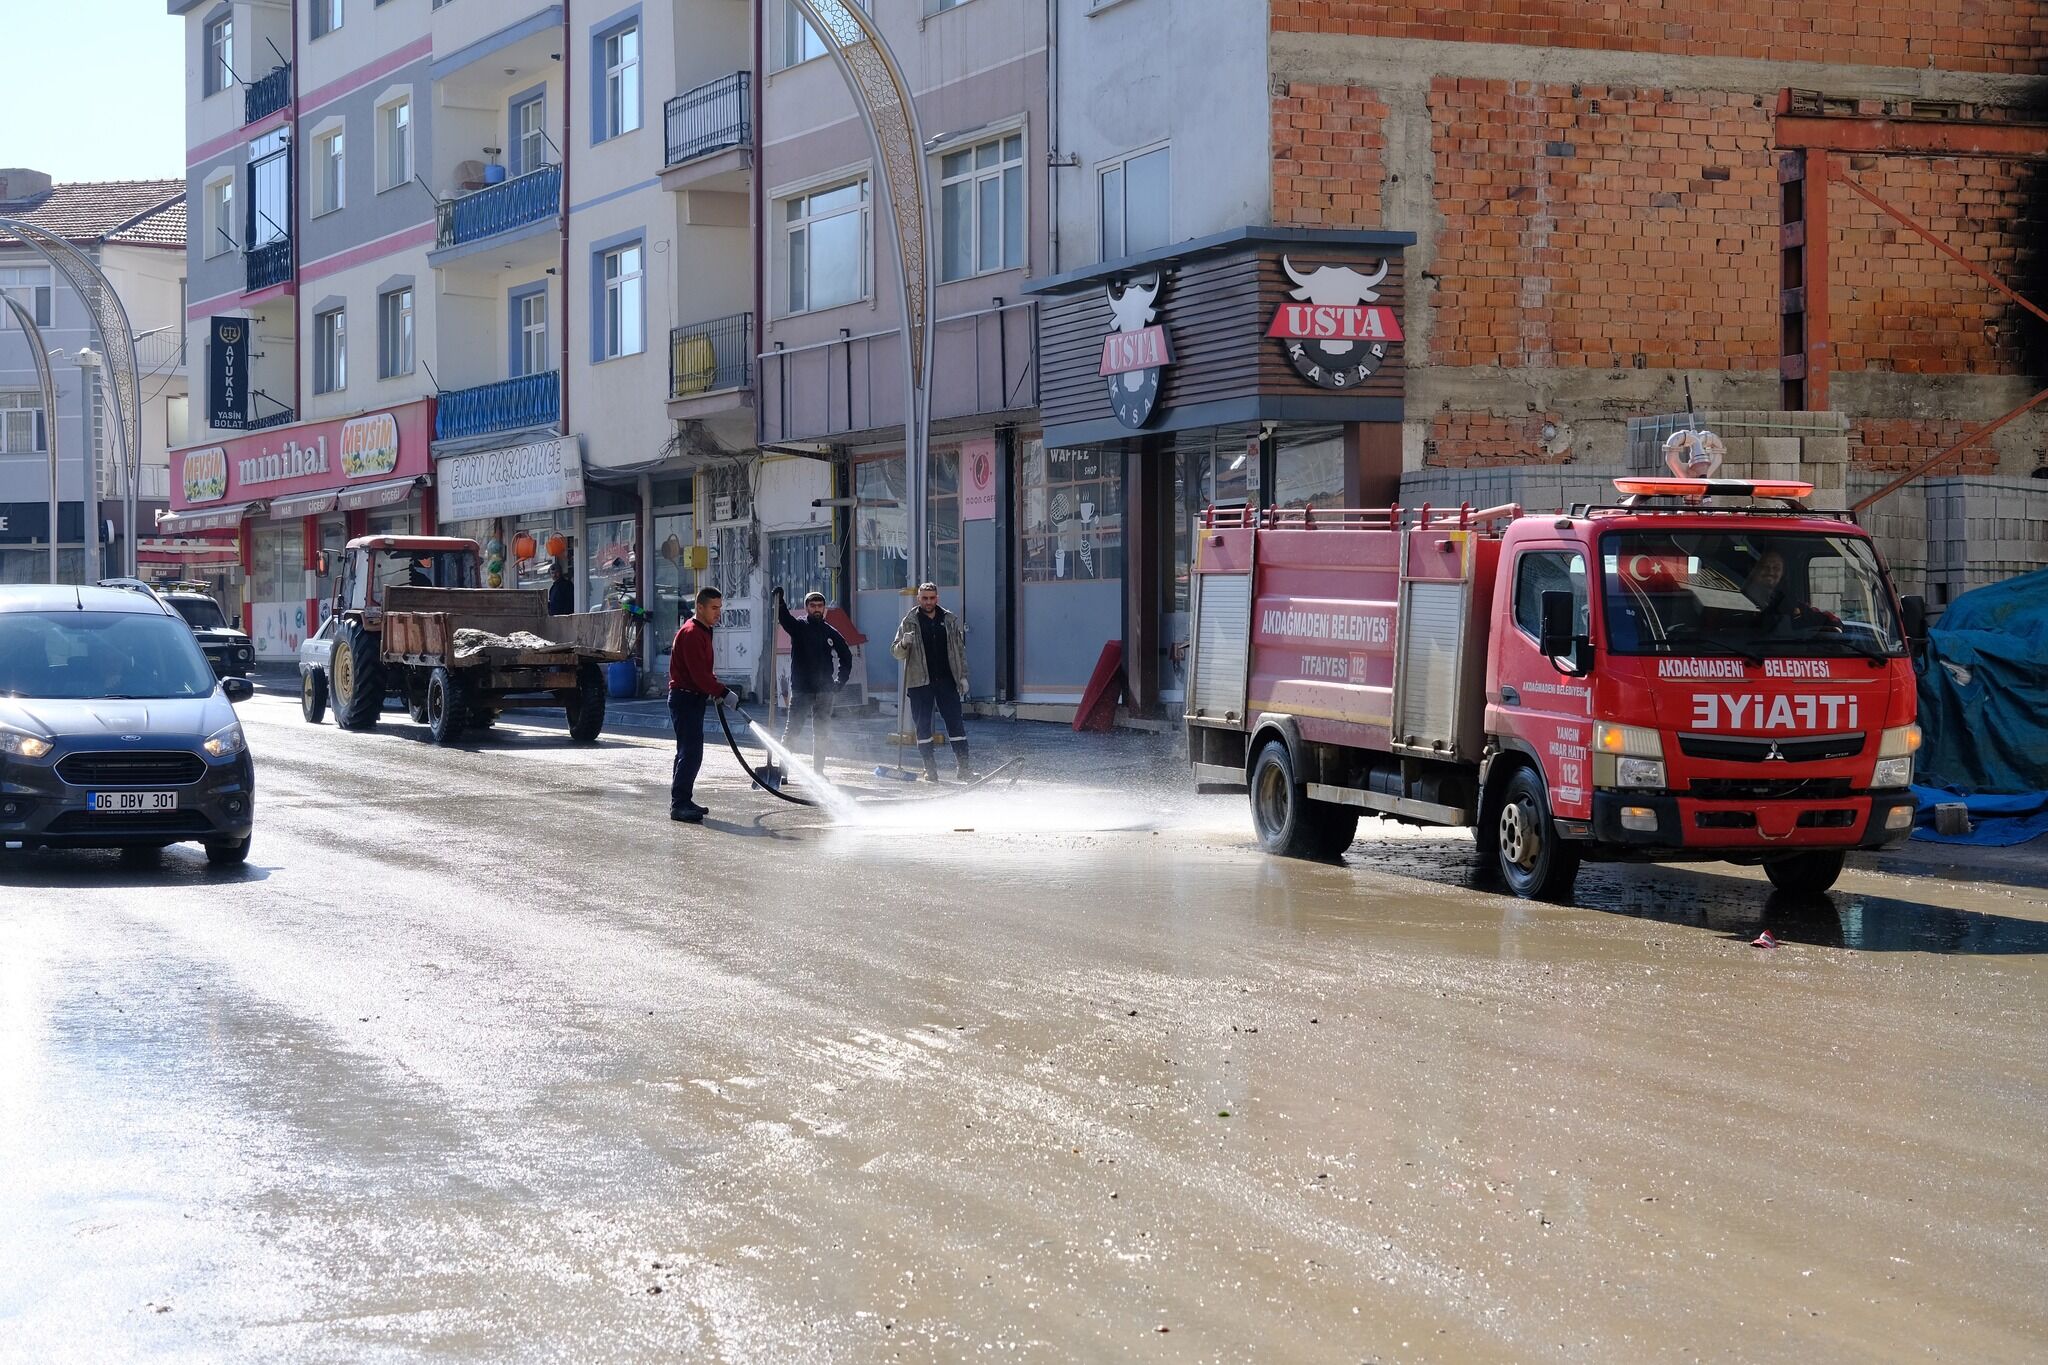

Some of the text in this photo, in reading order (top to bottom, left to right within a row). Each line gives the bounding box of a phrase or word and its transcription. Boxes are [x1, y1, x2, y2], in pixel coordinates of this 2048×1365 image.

[1287, 306, 1385, 338] USTA
[1109, 330, 1160, 370] USTA
[1289, 343, 1385, 386] KASAP
[225, 346, 235, 408] AVUKAT
[1110, 372, 1158, 422] KASAP
[214, 419, 243, 428] BOLAT
[1084, 465, 1098, 476] SHOP
[1261, 605, 1389, 643] AKDAĞMADENİ BELEDİYESİ
[1301, 656, 1348, 678] İTFAİYESİ
[1352, 657, 1365, 675] 112
[1658, 657, 1830, 678] AKDAĞMADENİ BELEDİYESİ
[1557, 726, 1580, 742] YANGIN
[1568, 743, 1587, 760] HATTI
[1562, 763, 1579, 785] 112
[96, 793, 174, 808] 06 DBV 301
